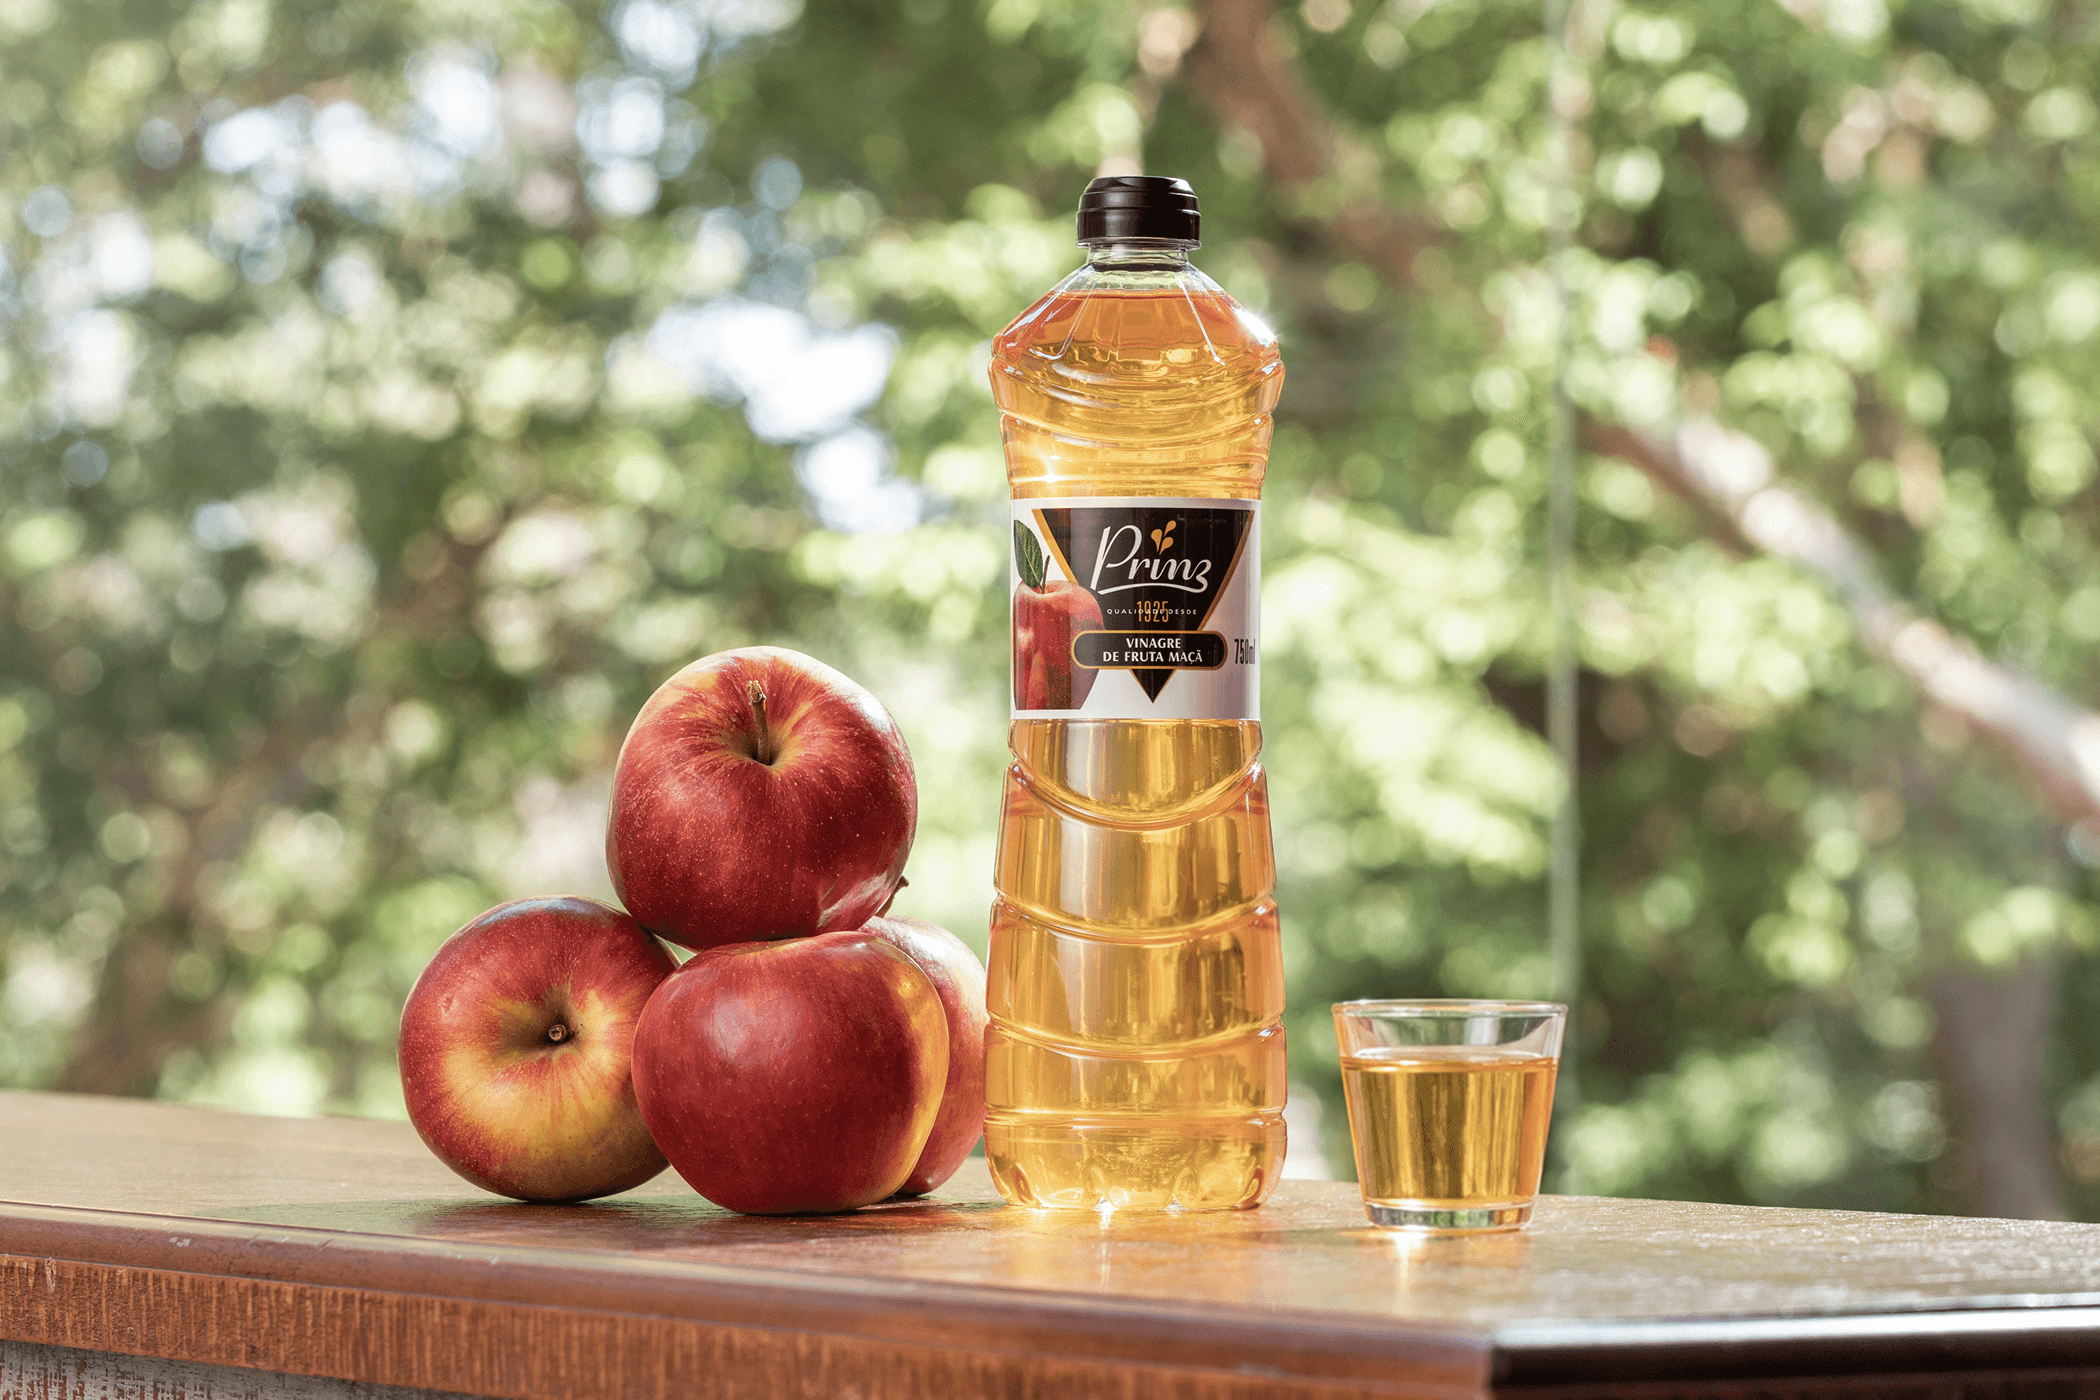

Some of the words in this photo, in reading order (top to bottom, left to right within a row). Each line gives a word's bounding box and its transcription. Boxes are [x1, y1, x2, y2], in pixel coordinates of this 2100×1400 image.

[1136, 600, 1169, 623] 1925
[1125, 637, 1182, 649] VINAGRE
[1102, 651, 1119, 662] DE
[1124, 651, 1164, 663] FRUTA
[1168, 649, 1203, 665] MAÇÃ
